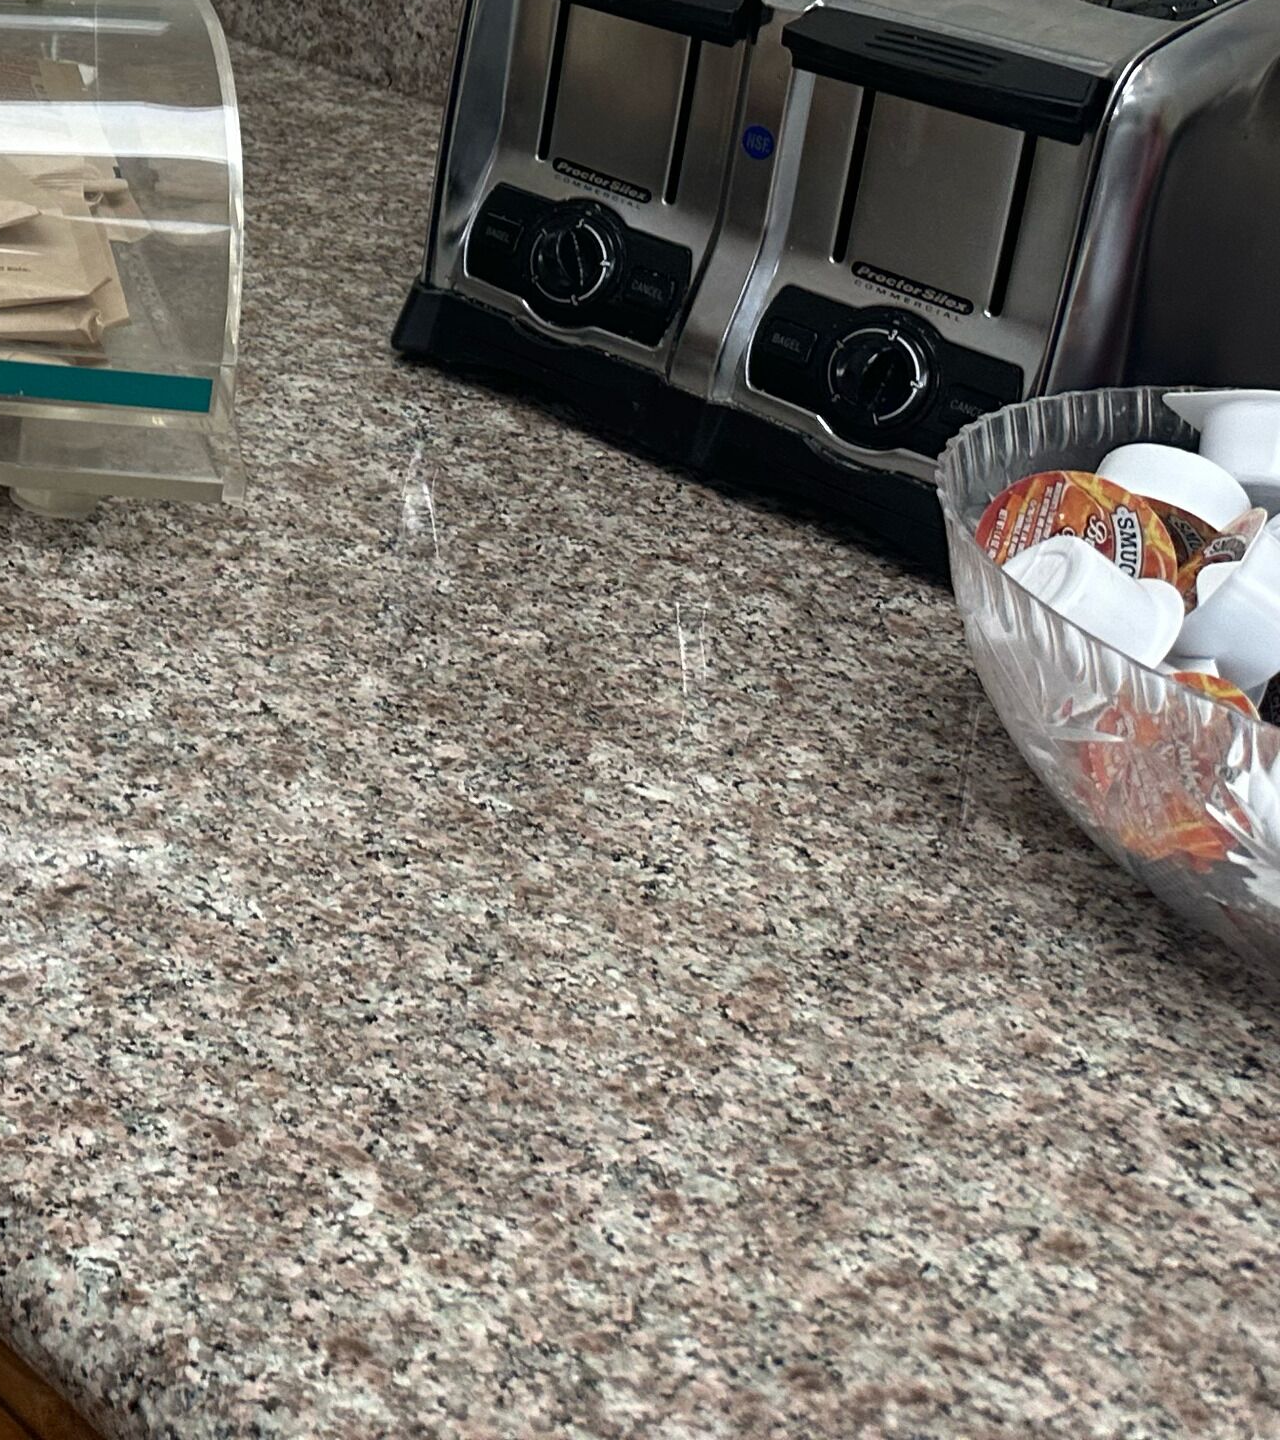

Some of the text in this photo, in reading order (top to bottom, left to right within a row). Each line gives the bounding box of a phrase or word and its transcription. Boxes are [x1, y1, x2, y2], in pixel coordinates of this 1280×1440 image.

[854, 279, 961, 323] COMMERCIAL
[771, 333, 801, 353] BAGEL
[949, 398, 984, 419] CANC
